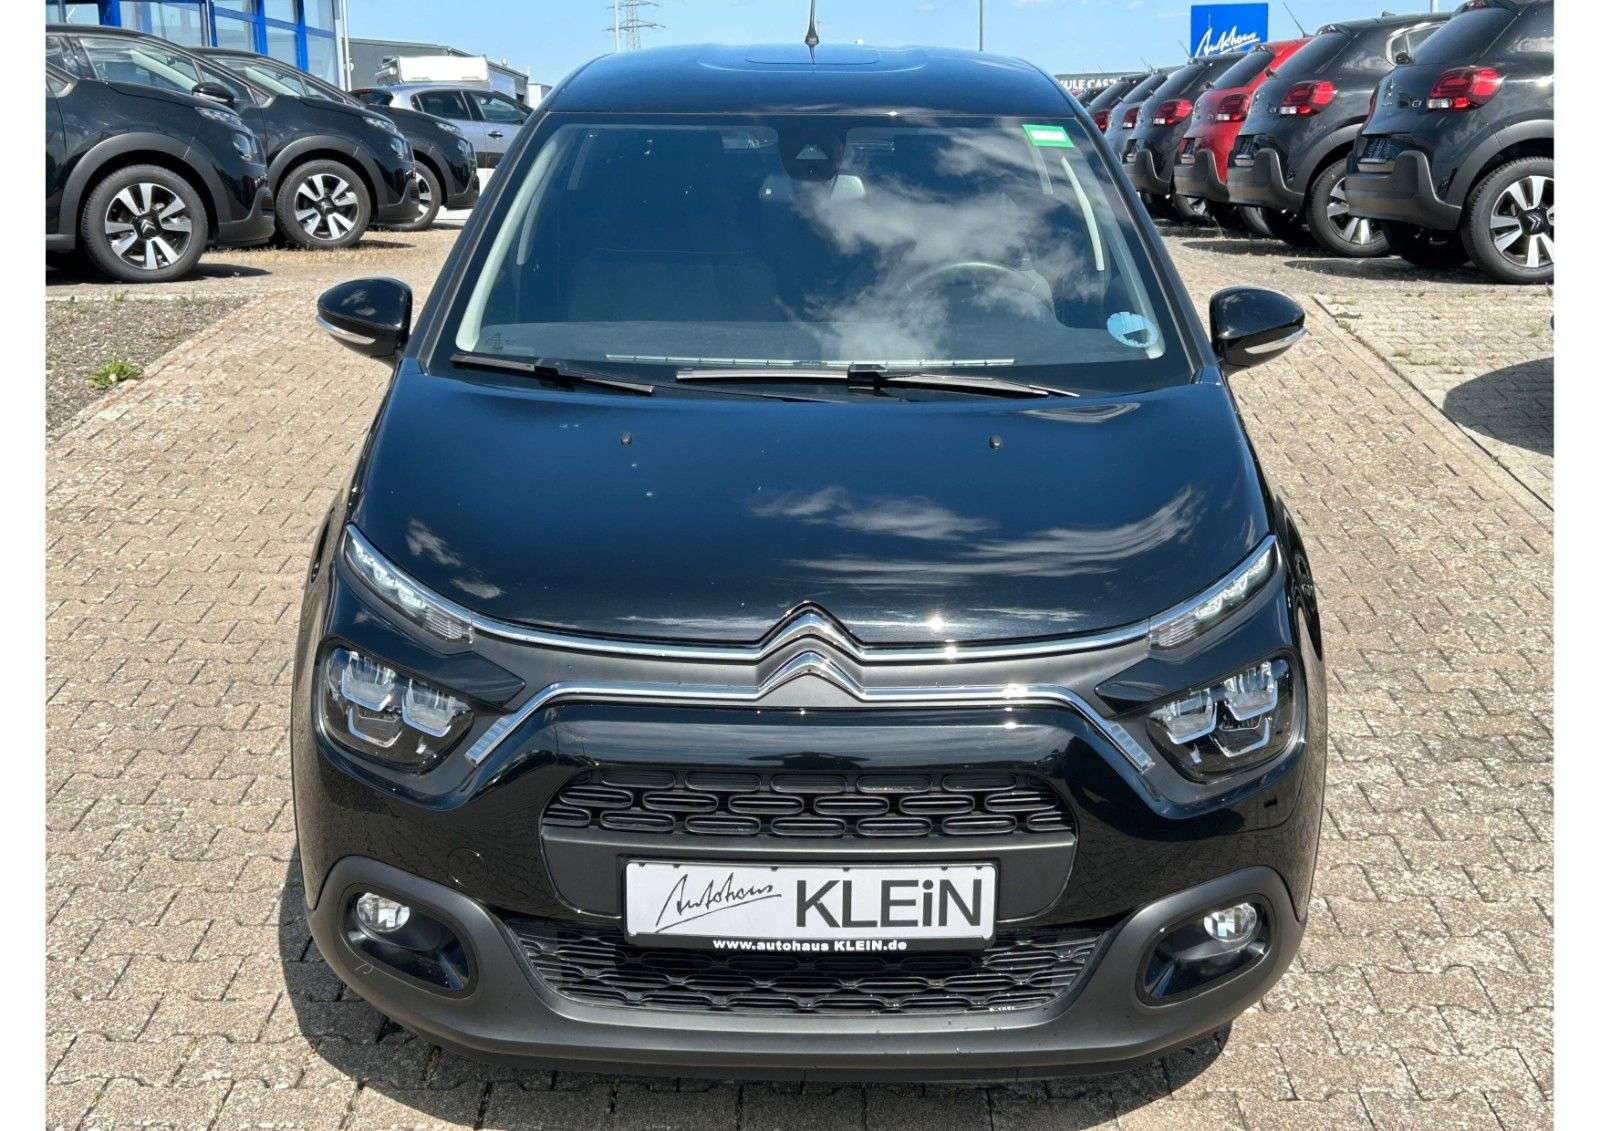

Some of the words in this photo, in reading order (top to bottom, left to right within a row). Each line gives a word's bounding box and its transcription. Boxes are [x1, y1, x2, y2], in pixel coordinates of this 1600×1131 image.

[655, 872, 781, 931] Autohaus
[713, 939, 829, 952] www.autohaus
[834, 939, 907, 952] KLEIN.de
